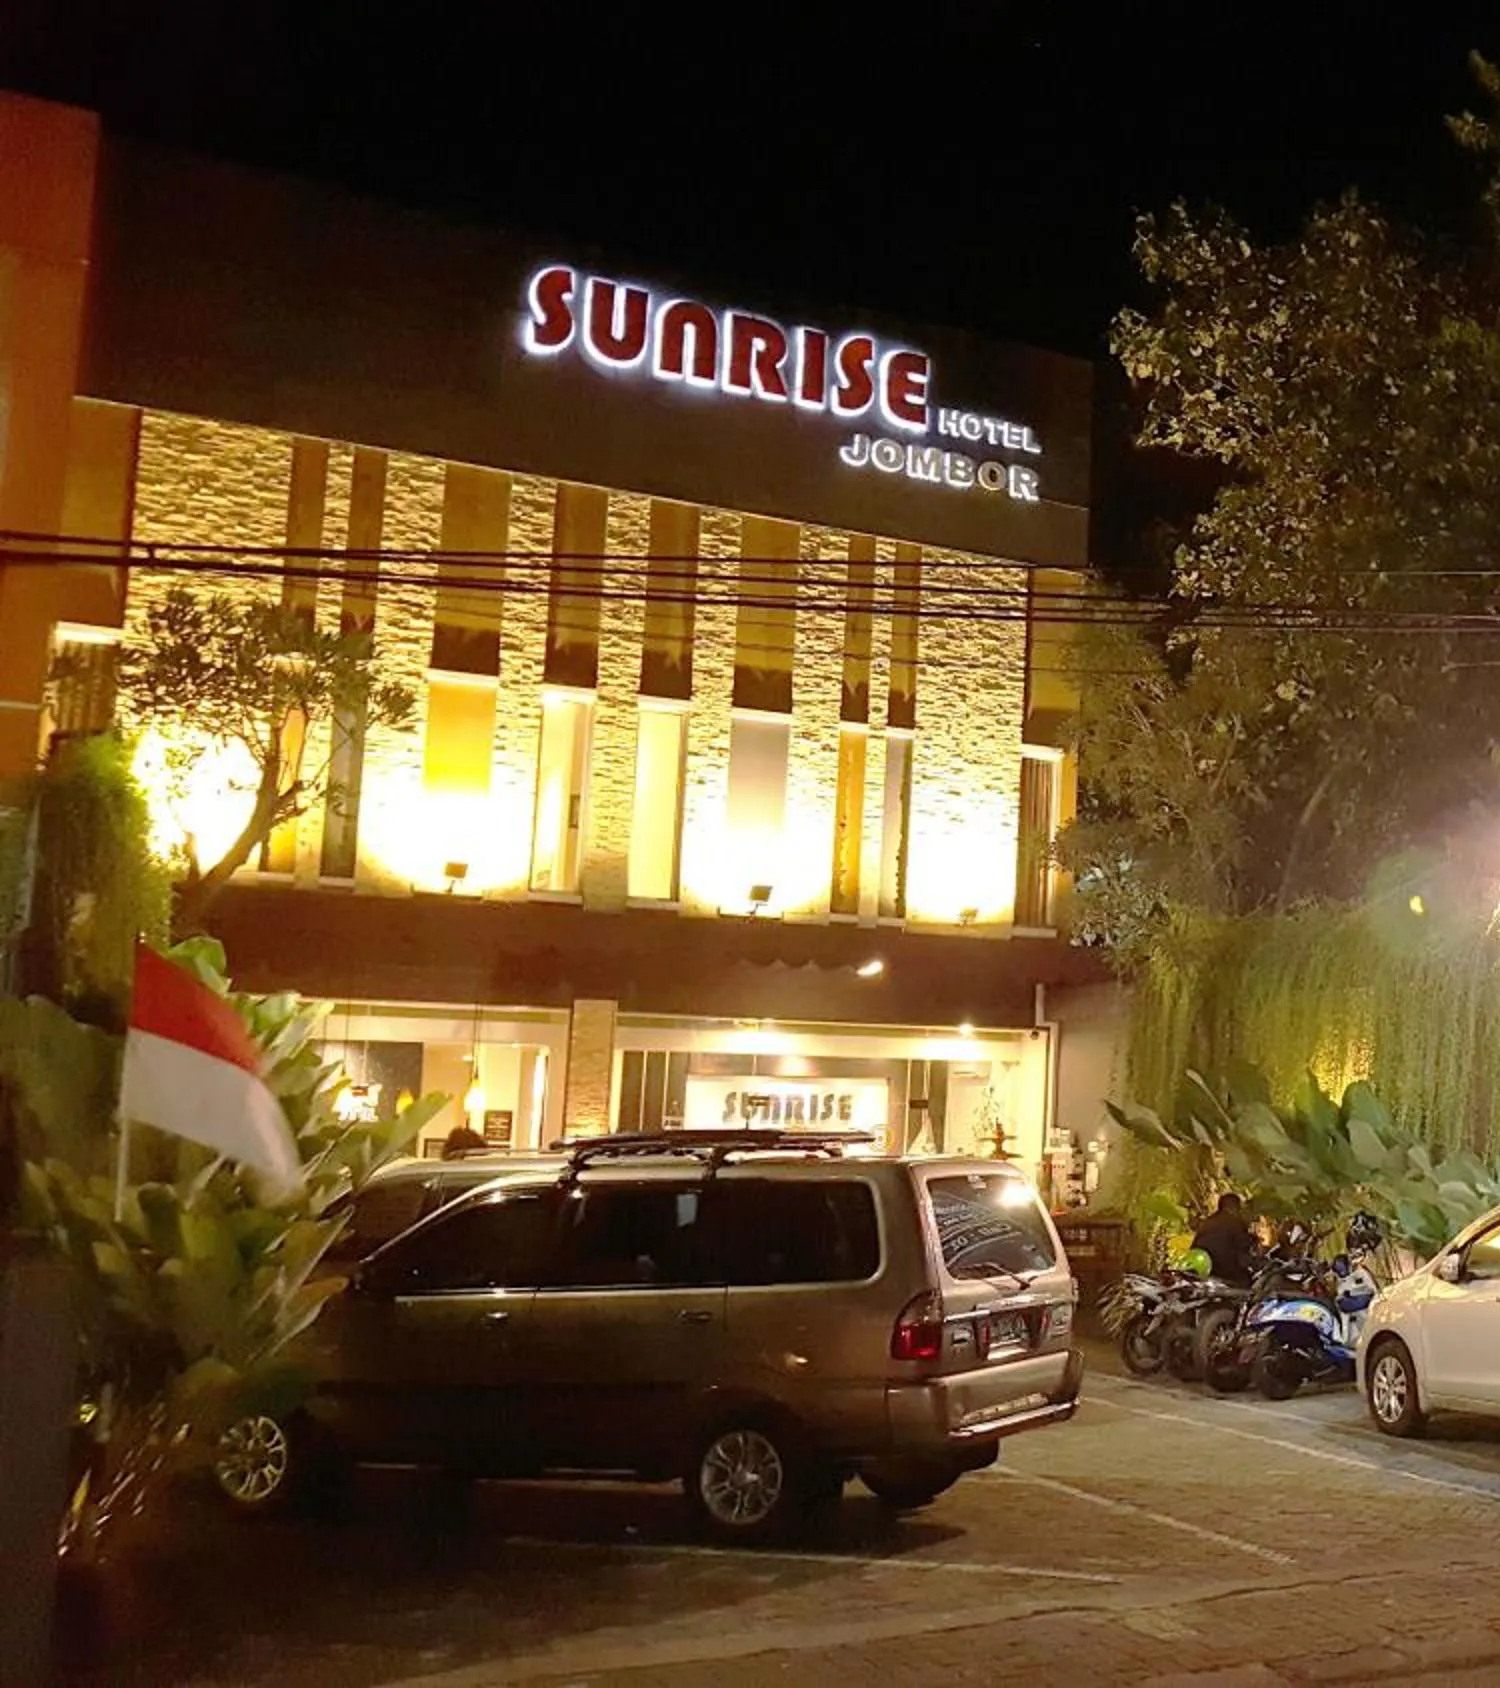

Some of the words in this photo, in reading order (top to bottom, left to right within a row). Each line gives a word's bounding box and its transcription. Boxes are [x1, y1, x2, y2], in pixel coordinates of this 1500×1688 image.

[526, 266, 932, 432] SUNRISE
[938, 407, 1042, 454] HOTEL
[839, 432, 1041, 502] JOMBOR
[722, 1091, 854, 1125] SUNRISE
